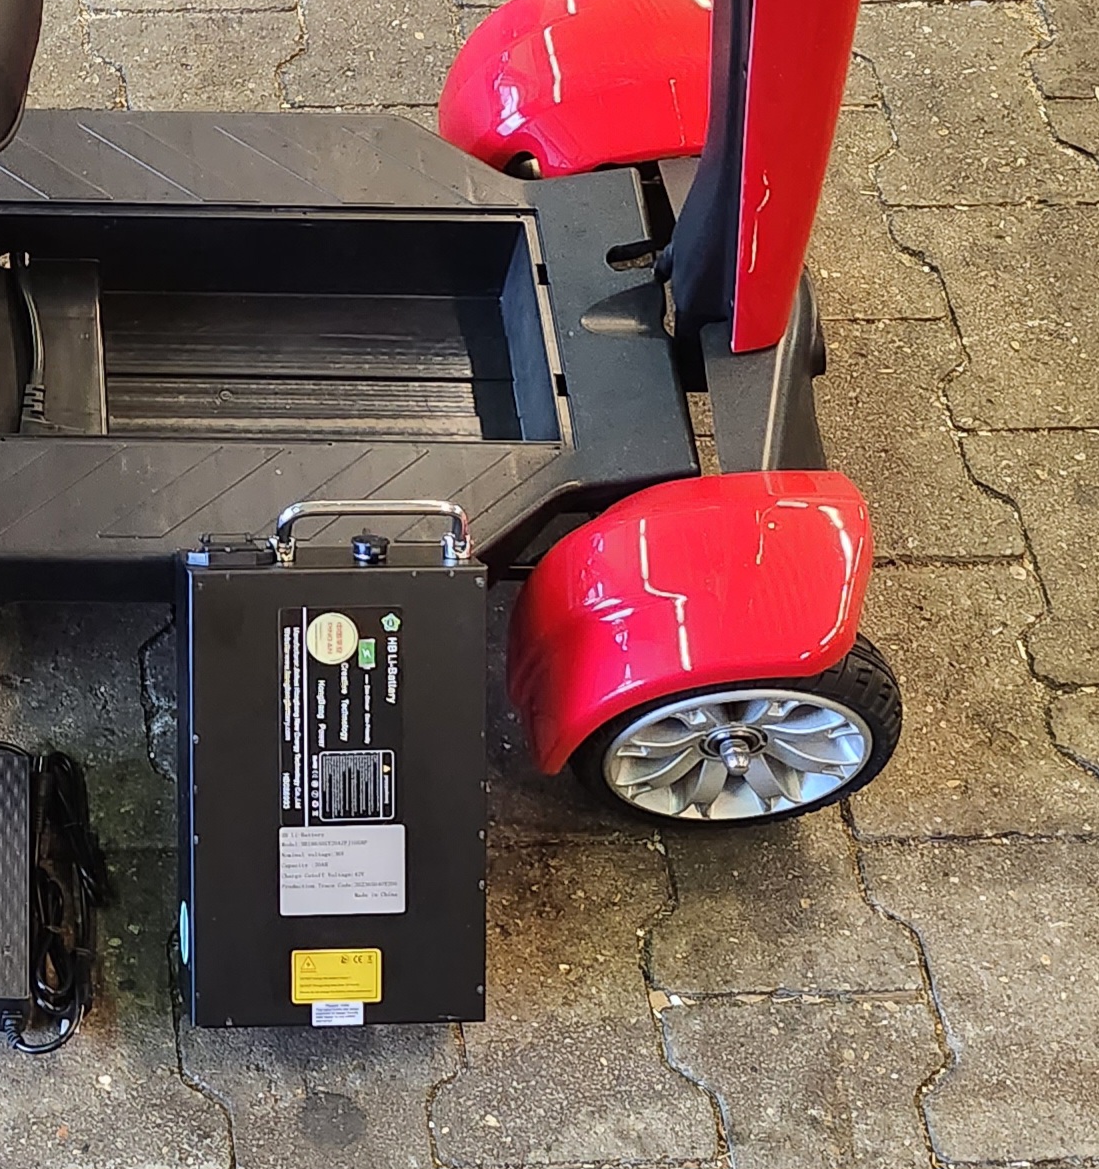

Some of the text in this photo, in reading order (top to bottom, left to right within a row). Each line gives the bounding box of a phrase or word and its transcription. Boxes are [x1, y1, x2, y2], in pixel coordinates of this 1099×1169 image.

[387, 637, 398, 653] HB
[340, 662, 350, 742] Creative Technology
[318, 723, 327, 748] Power
